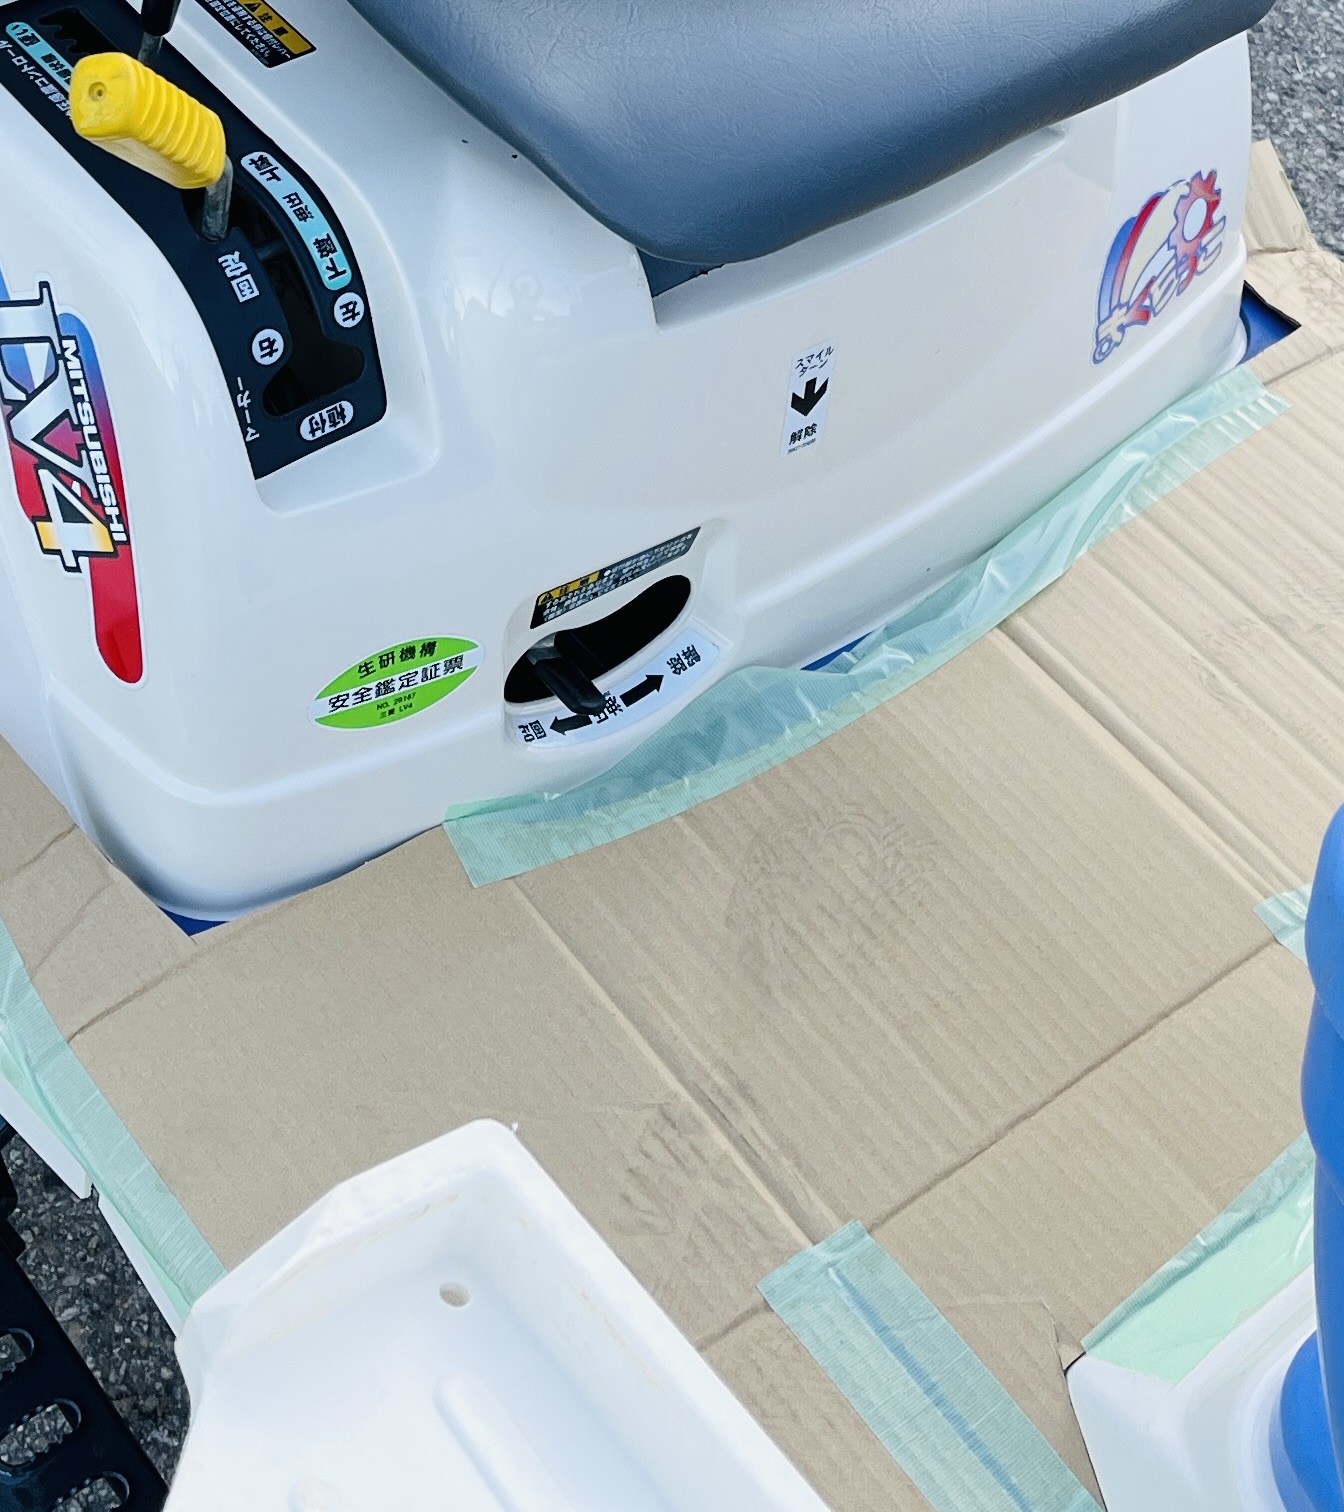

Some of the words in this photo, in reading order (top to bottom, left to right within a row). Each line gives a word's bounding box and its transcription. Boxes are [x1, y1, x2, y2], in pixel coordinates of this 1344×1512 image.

[248, 154, 281, 182] 上昇
[313, 232, 347, 281] 下降
[217, 250, 260, 303] 固定
[339, 300, 361, 323] 左
[258, 336, 279, 359] 右
[795, 345, 834, 370] スマイル
[799, 359, 829, 378] ターン
[236, 376, 260, 442] マーカー
[308, 403, 347, 438] 植付
[59, 339, 129, 544] MITSUBISHI
[789, 422, 818, 446] 解除
[357, 640, 438, 679] 生研機構
[667, 644, 702, 676] 解除
[328, 653, 464, 713] 安全鑑定証票
[518, 719, 548, 743] 固定
